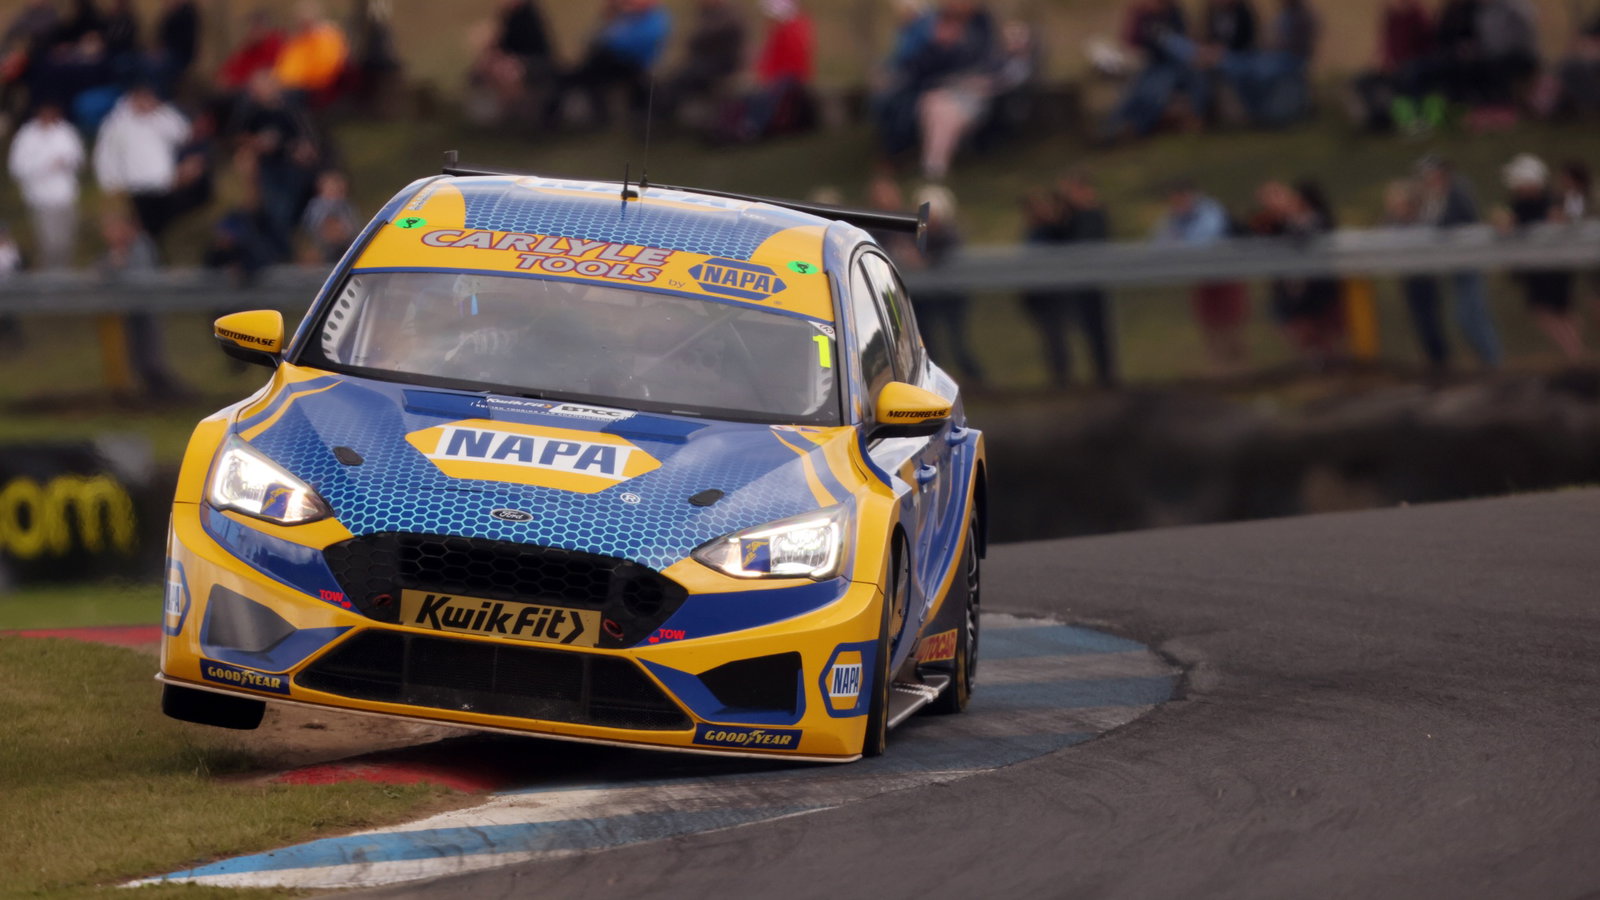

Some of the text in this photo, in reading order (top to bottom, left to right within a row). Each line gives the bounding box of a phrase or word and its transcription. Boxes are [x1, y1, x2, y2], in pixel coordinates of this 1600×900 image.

[420, 228, 676, 268] CARLYLE
[516, 253, 662, 284] TOOLS
[703, 265, 771, 293] NAPA
[668, 279, 686, 289] by
[217, 327, 276, 347] MOTORBASE
[812, 335, 831, 368] 1
[887, 407, 949, 419] MOTORBASE
[445, 429, 617, 475] NAPA
[319, 589, 345, 603] TOW
[658, 628, 686, 640] TOW
[832, 665, 860, 695] NAPA
